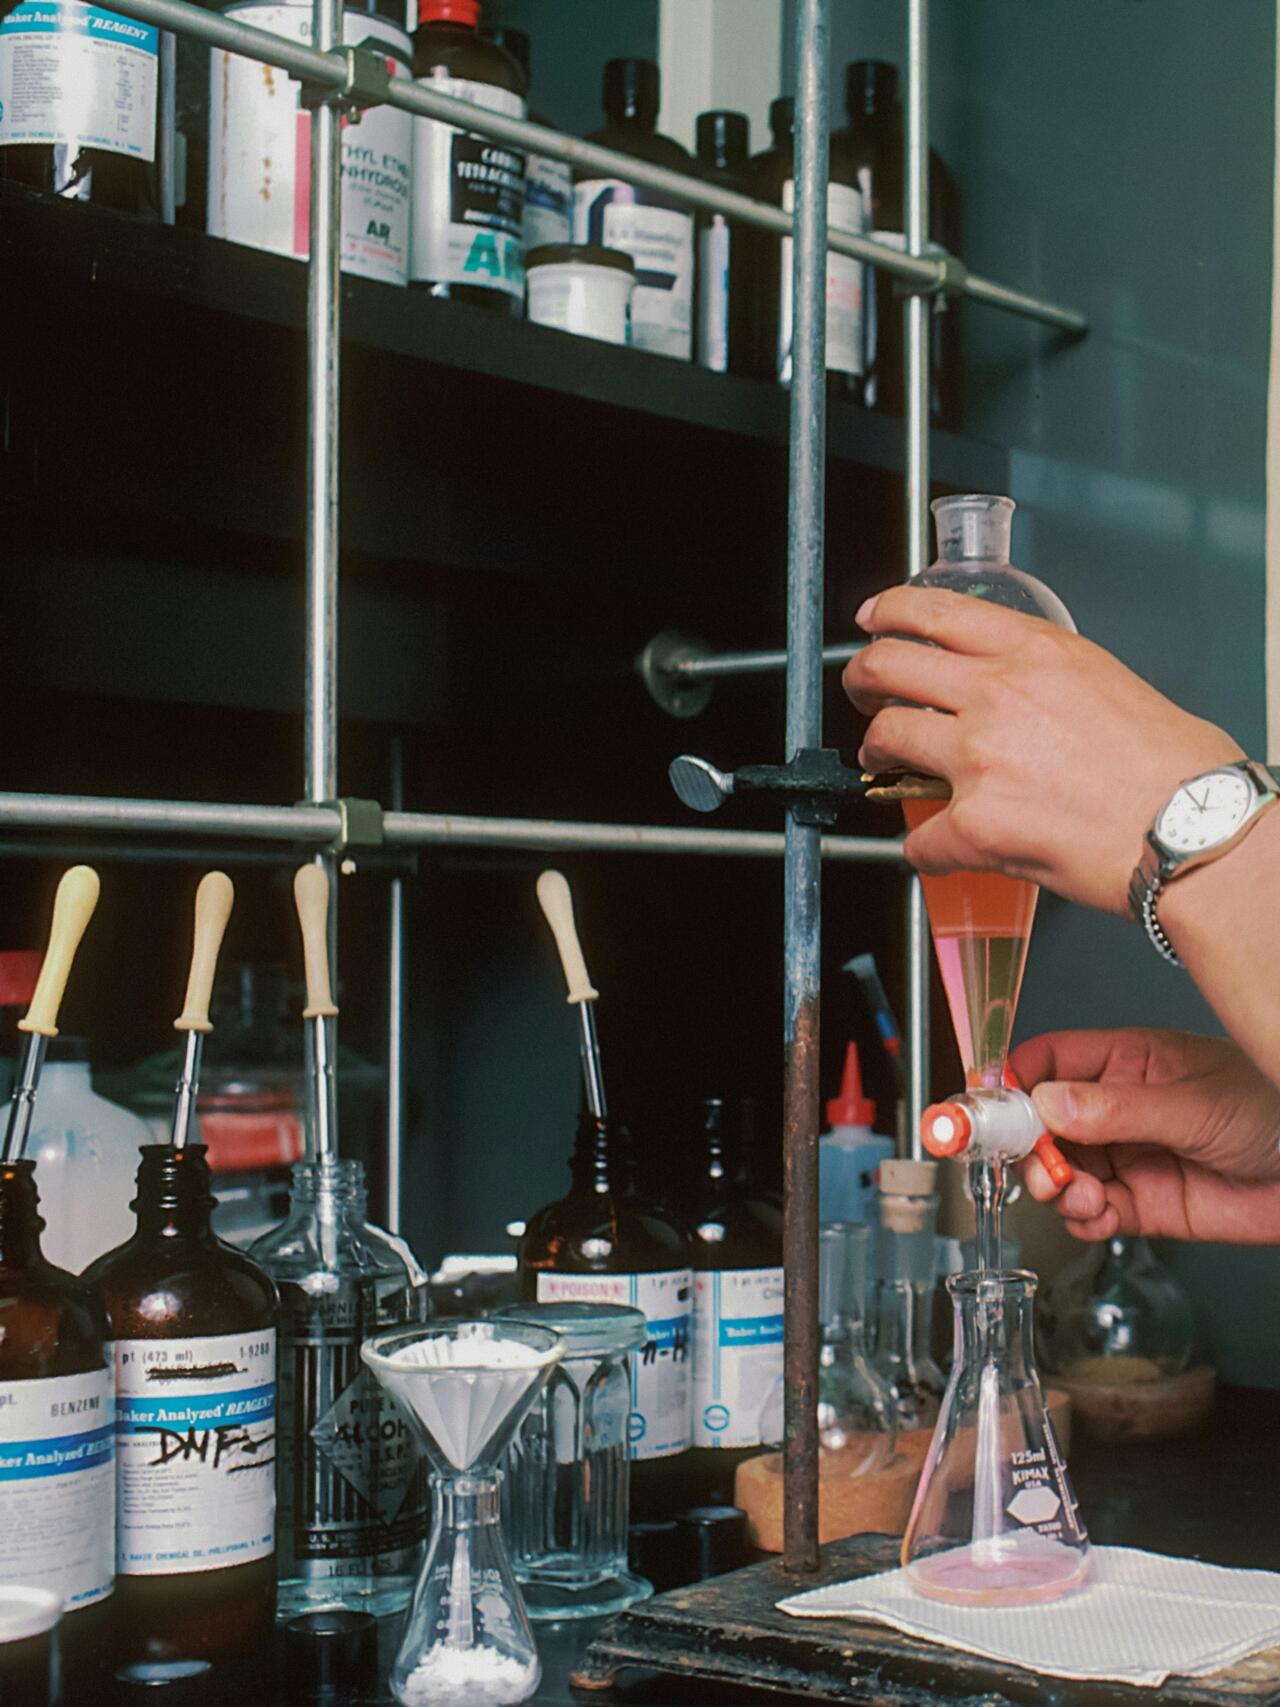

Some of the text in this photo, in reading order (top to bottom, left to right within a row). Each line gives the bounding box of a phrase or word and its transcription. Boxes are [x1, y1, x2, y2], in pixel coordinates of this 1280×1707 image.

[92, 17, 149, 40] REAGENT
[561, 1281, 609, 1296] POISON
[51, 1395, 100, 1417] BENZENE
[1011, 1447, 1047, 1466] 125ml
[1012, 1466, 1050, 1486] KIMAX
